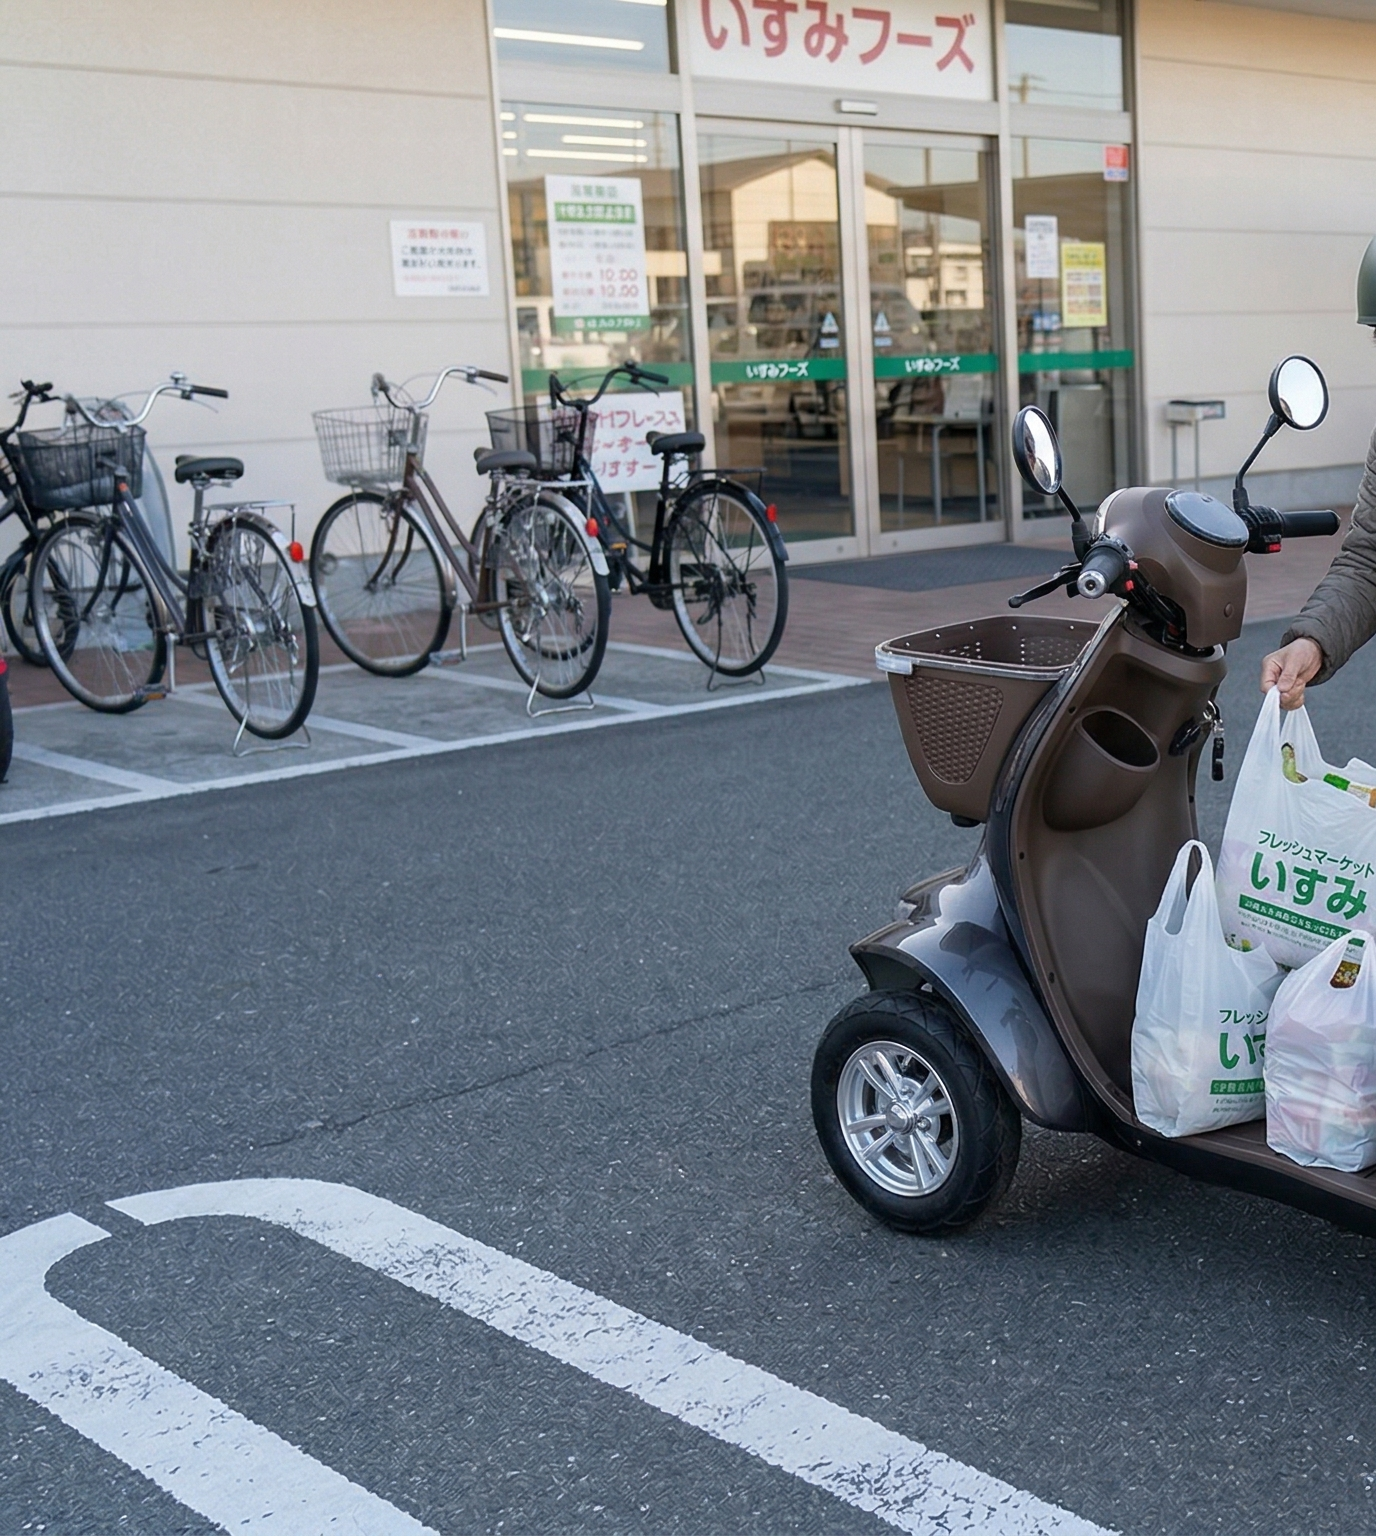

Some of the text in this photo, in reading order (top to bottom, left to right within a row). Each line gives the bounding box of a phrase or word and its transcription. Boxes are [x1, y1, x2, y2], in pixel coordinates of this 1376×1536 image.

[702, 0, 975, 73] いすみフーズ
[745, 361, 809, 379] いすみフーズ
[905, 356, 961, 373] いすみフーズ
[1258, 830, 1375, 878] フレッシュマーケット
[1250, 851, 1368, 921] いすみ
